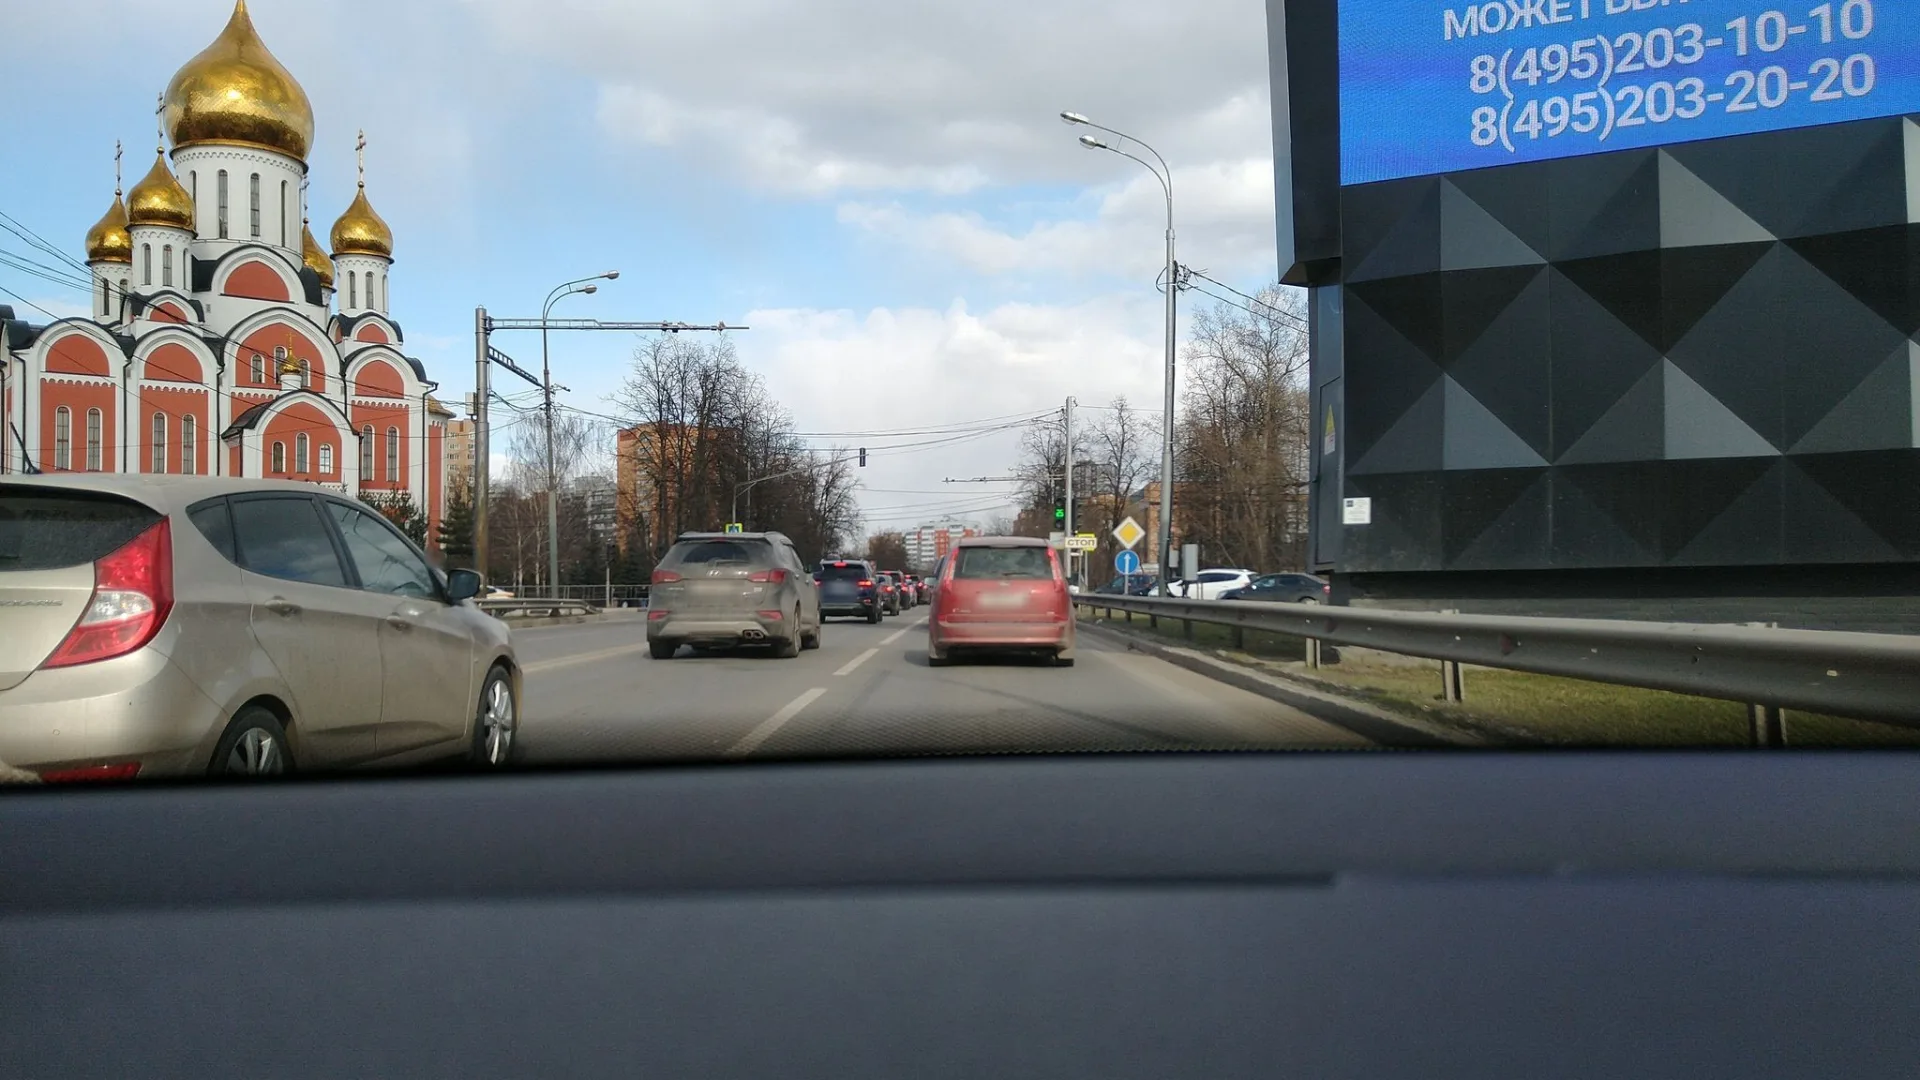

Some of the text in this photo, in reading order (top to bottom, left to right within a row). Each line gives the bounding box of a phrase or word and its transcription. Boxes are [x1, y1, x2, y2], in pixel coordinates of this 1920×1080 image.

[1469, 0, 1874, 101] 8(495)203-10-10
[1470, 52, 1876, 153] 8(495)203-20-20
[1067, 538, 1095, 546] СТОП
